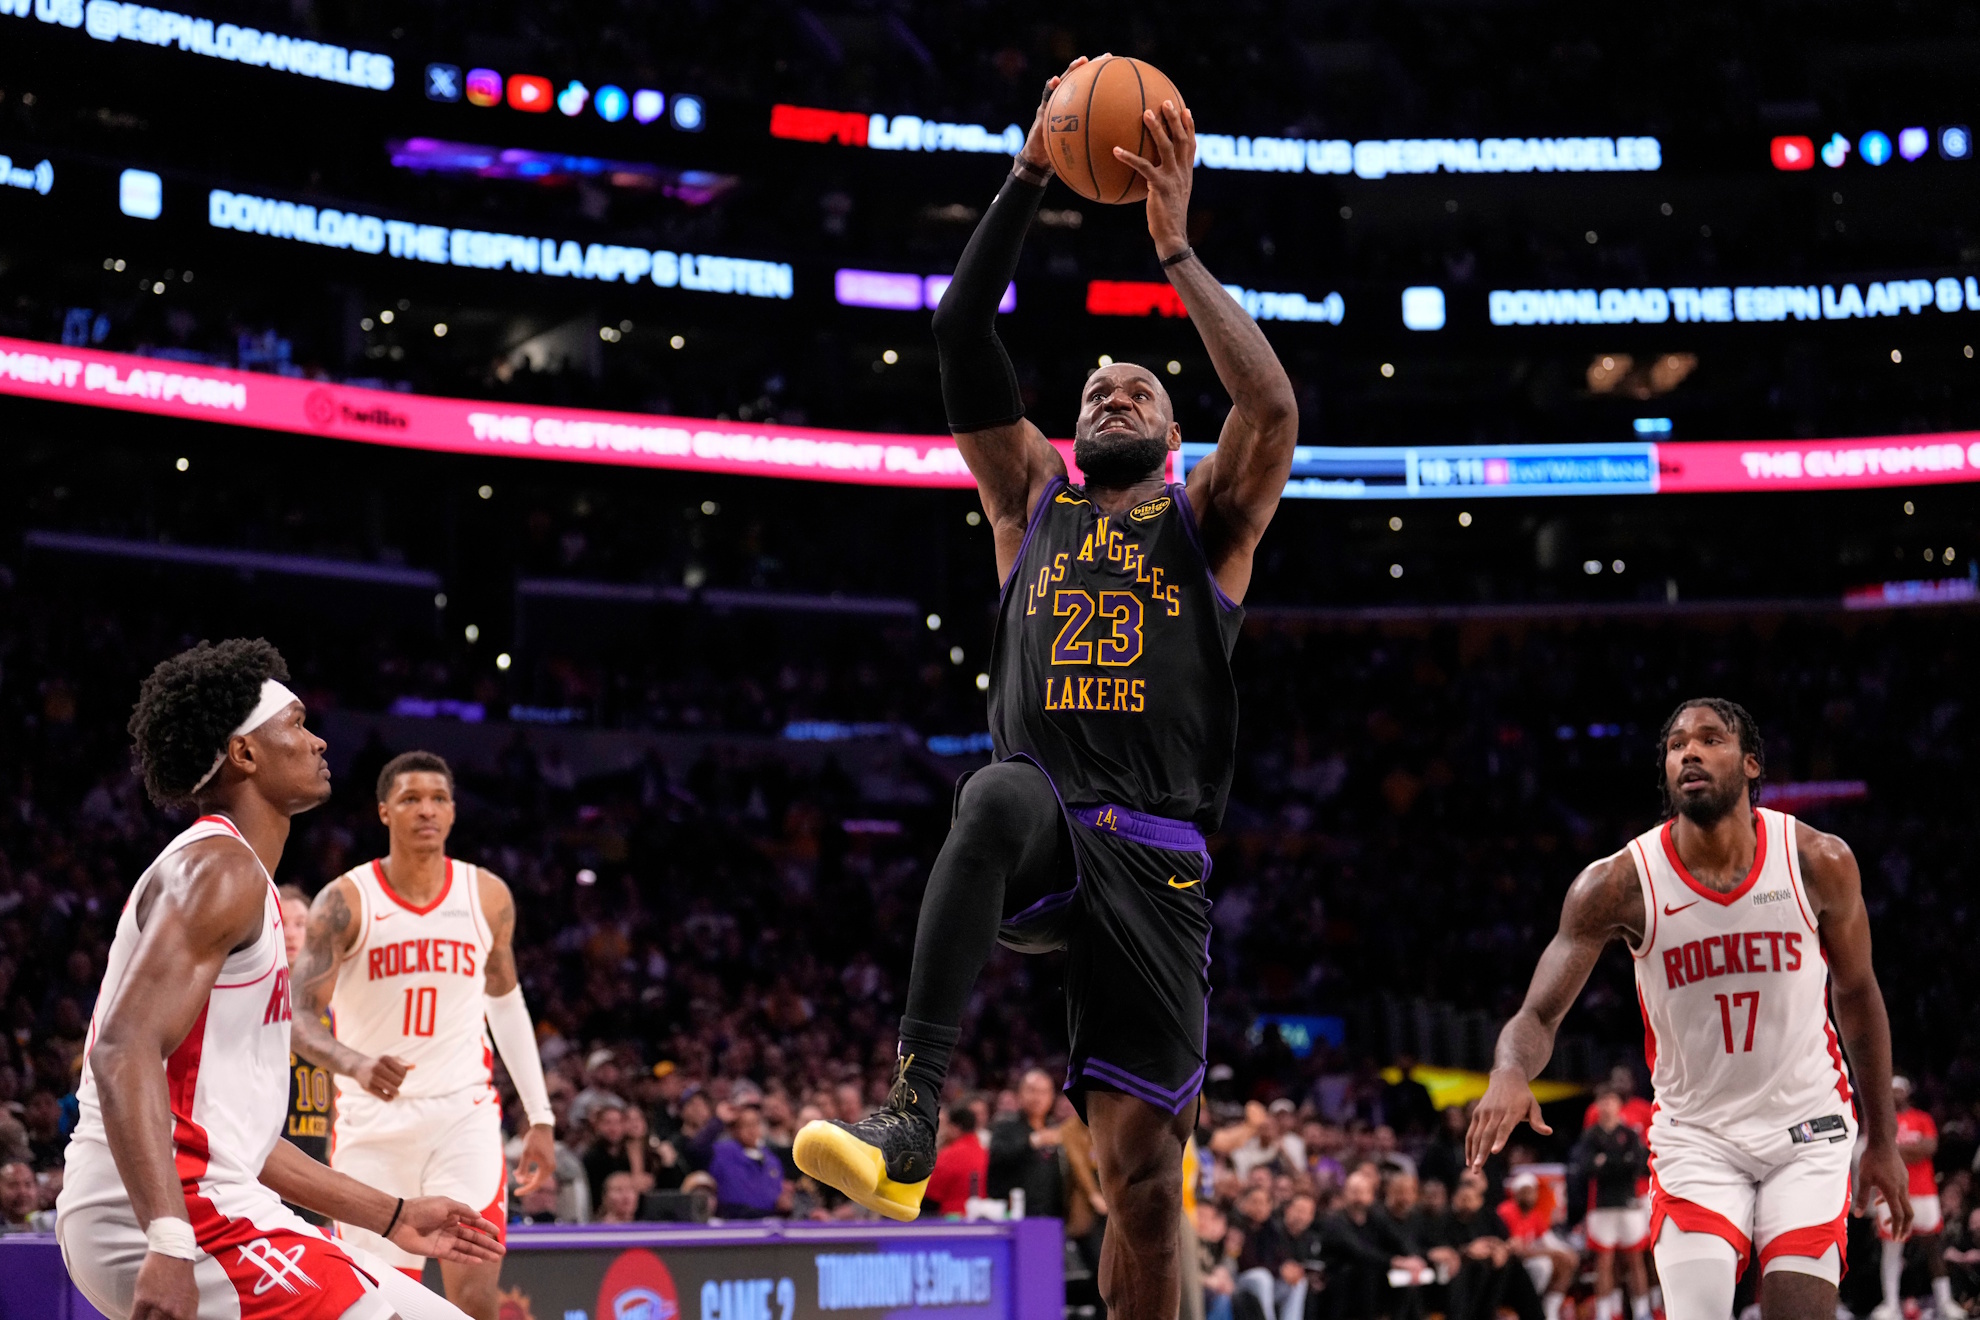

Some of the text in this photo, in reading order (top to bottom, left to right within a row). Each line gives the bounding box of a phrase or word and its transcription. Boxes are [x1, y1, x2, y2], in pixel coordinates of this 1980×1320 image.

[1306, 139, 1352, 174] US
[209, 189, 386, 254] DOWNLOAD
[386, 220, 450, 264] THE
[450, 229, 540, 273] ESPN
[541, 238, 583, 278] LA
[584, 244, 651, 284] APP
[680, 254, 793, 299] LISTEN
[1488, 288, 1669, 326] DOWNLOAD
[1669, 287, 1733, 323] THE
[1734, 285, 1821, 322] ESPN
[1821, 284, 1867, 320] LA
[1867, 279, 1934, 318] APP
[85, 363, 247, 411] PLATFORM
[467, 412, 532, 444] THE
[532, 418, 691, 456] CUSTOMER
[692, 431, 884, 471] ENGAGEMENT
[1741, 451, 1803, 478] THE
[1804, 444, 1965, 477] CUSTOMER
[1134, 501, 1168, 515] bibigo
[1026, 515, 1180, 617] LOS ANGELES
[1050, 589, 1144, 667] 23
[1044, 676, 1146, 713] LAKERS
[1095, 807, 1118, 832] LAL
[368, 937, 477, 982] ROCKETS
[1662, 930, 1803, 990] ROCKETS
[402, 986, 438, 1038] 10
[1714, 990, 1760, 1055] 17
[295, 1066, 330, 1113] 10
